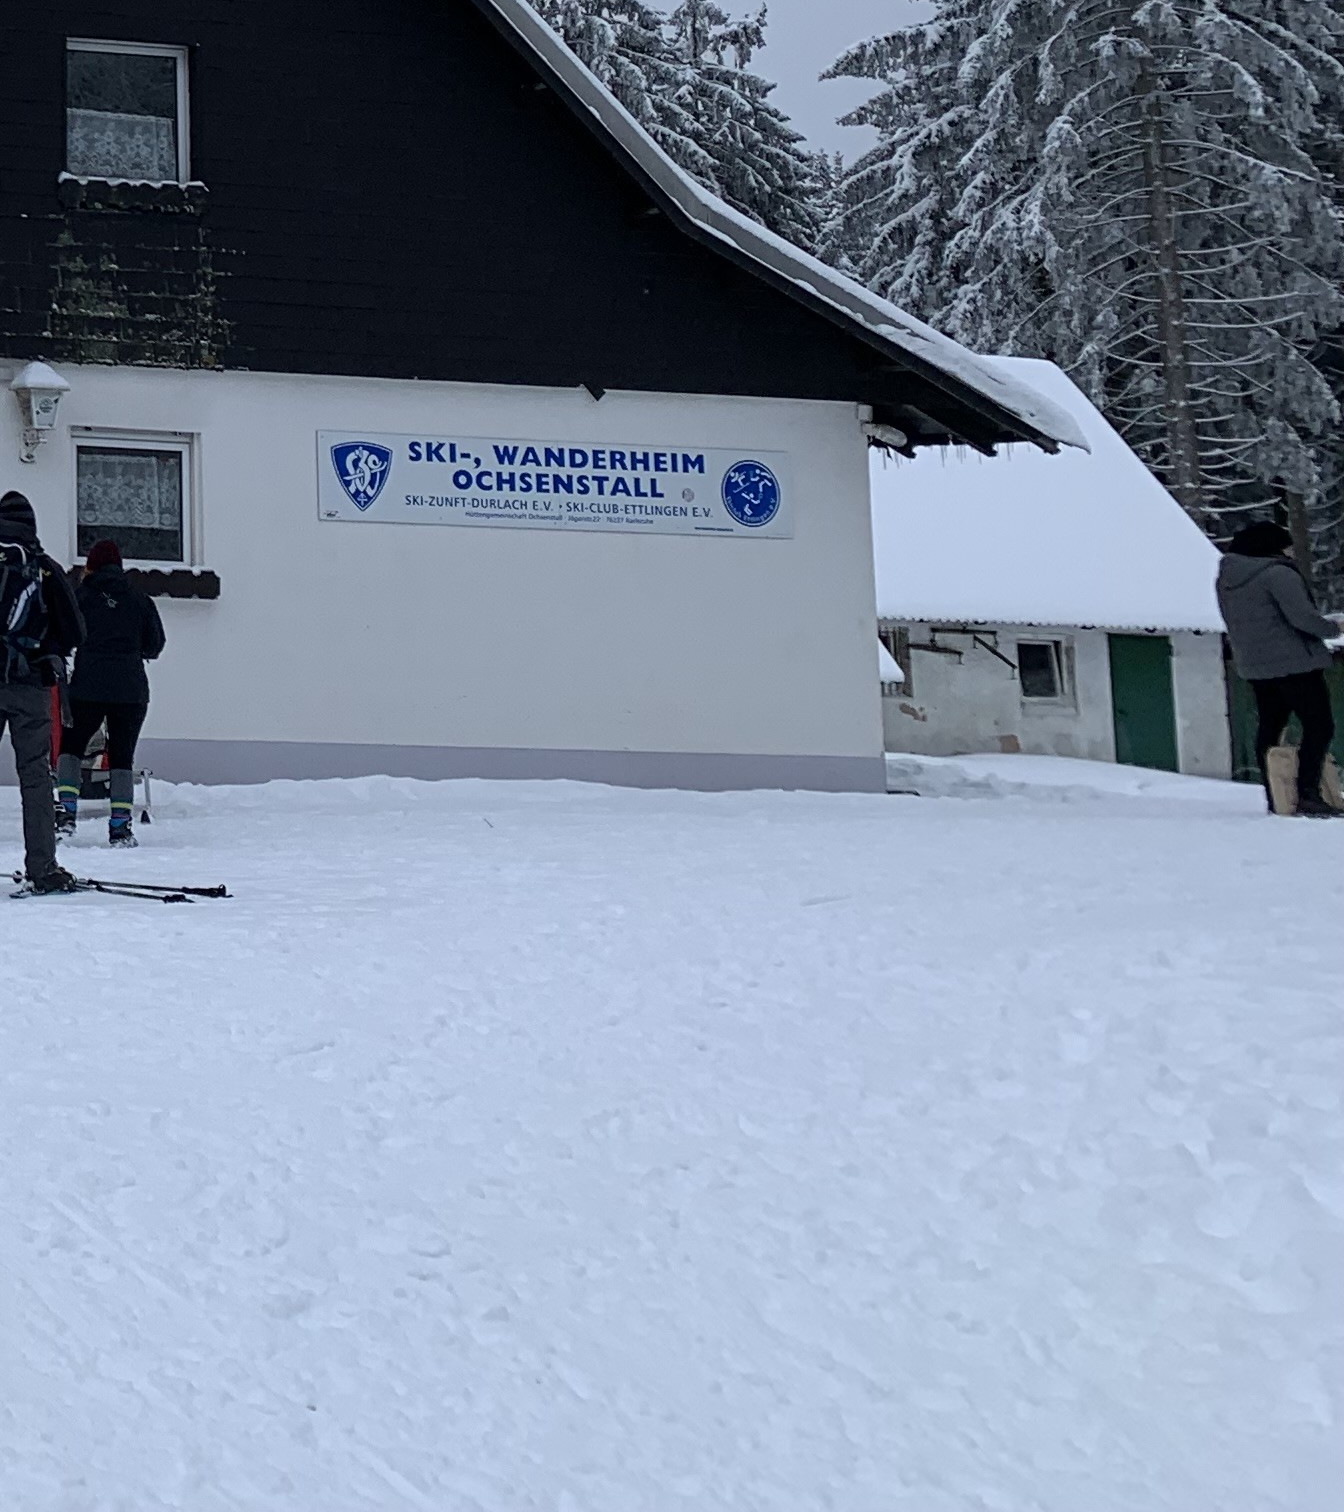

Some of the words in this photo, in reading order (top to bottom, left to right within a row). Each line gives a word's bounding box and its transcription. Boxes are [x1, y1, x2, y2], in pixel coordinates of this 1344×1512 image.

[493, 445, 705, 474] WANDERHEIM
[452, 469, 664, 498] OCHSENSTALL
[405, 495, 528, 510] SKI-ZUNFT-DURLACH
[532, 500, 554, 512] E.V.
[566, 501, 688, 517] SKI-CLUB-ETTLINGEN
[692, 506, 714, 518] E.V.
